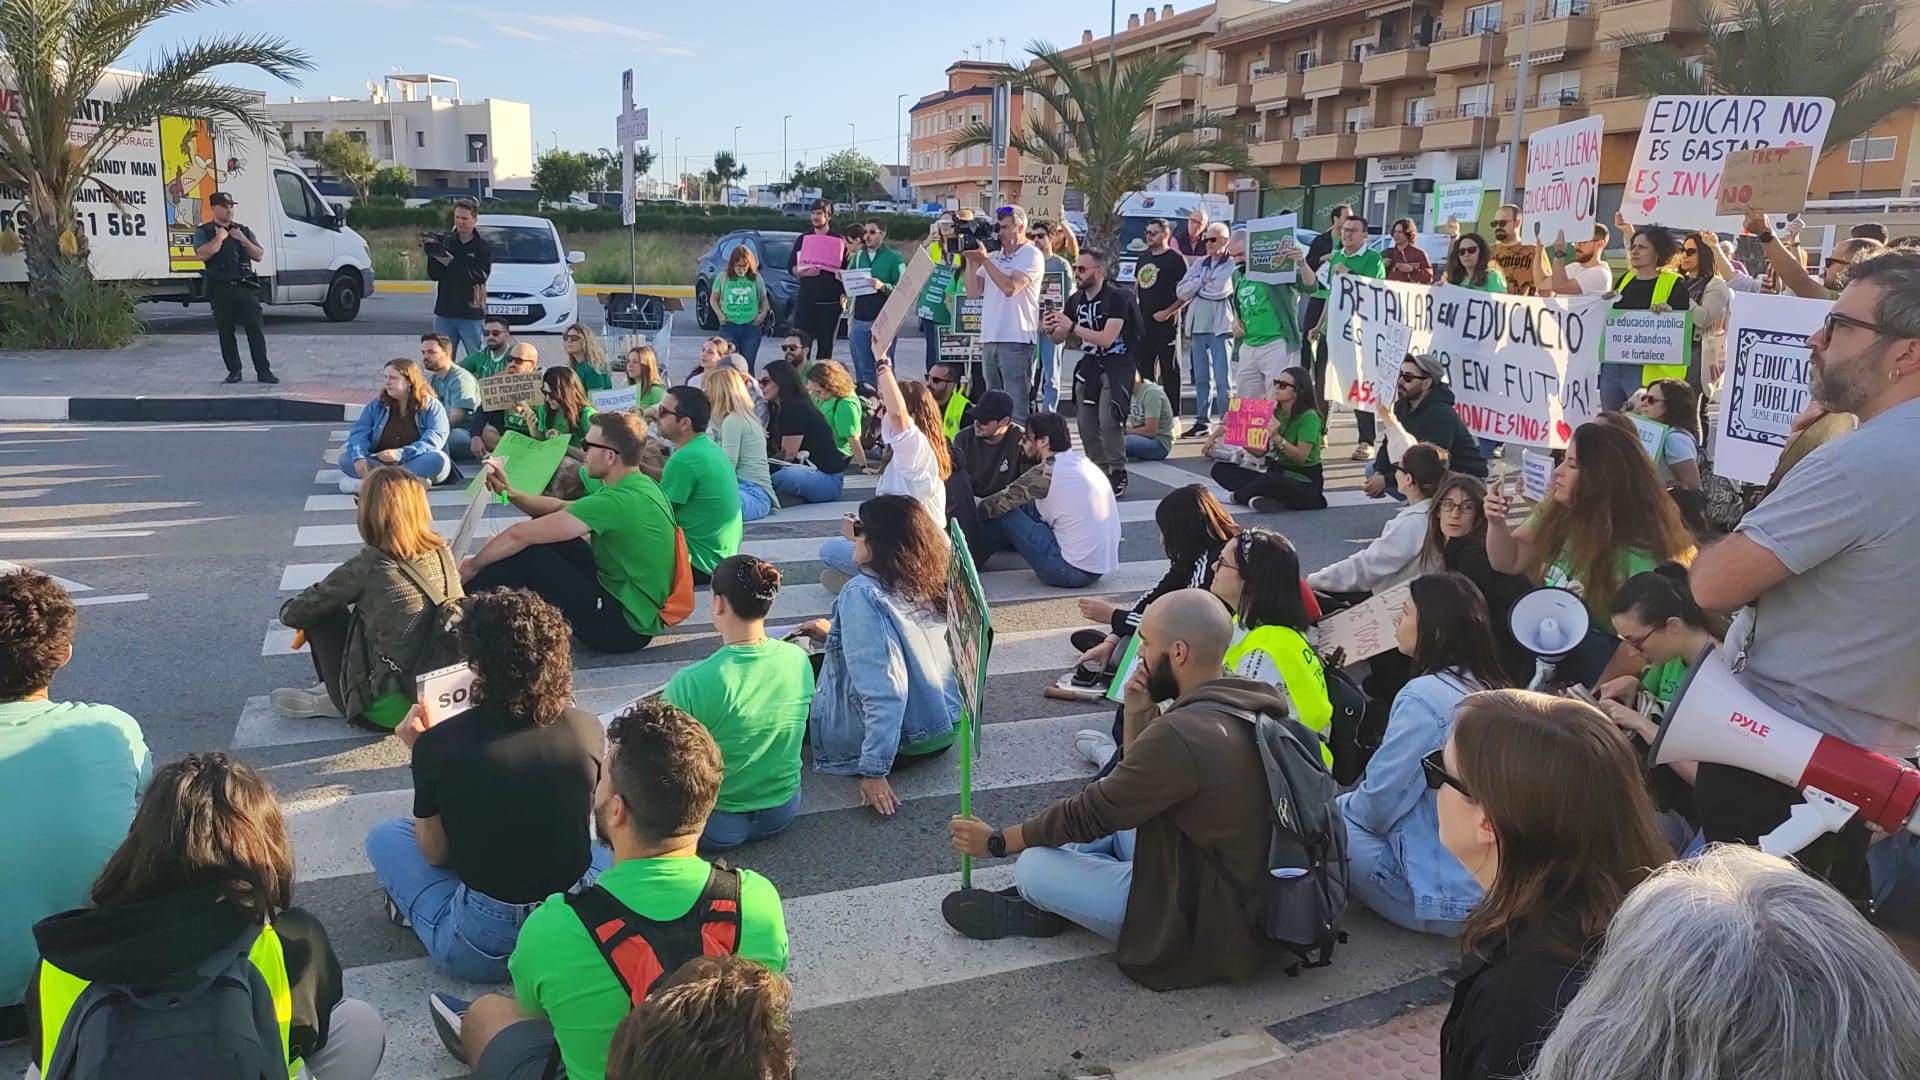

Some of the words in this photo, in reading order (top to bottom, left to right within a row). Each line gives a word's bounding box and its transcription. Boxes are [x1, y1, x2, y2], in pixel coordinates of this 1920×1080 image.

[1650, 99, 1767, 134] EDUCAR
[1779, 101, 1823, 134] NO
[1564, 130, 1599, 167] LLENA
[1648, 139, 1669, 161] ES
[131, 162, 157, 177] MAN
[1024, 175, 1062, 184] ESENCIAL
[1042, 166, 1052, 175] LO
[1037, 186, 1049, 196] ES
[1634, 169, 1661, 194] ES
[1524, 176, 1572, 214] EDUCACIÓN
[1028, 207, 1034, 216] A
[1038, 207, 1049, 216] LA
[108, 213, 147, 236] 562
[1437, 302, 1460, 328] EN
[1462, 298, 1588, 354] EDUCACIÓ
[1617, 316, 1655, 328] educación
[1657, 316, 1684, 331] pública
[1612, 334, 1622, 342] no
[1623, 334, 1632, 343] se
[1634, 332, 1673, 347] abandona,
[1621, 350, 1630, 359] se
[1631, 348, 1665, 360] fortalece
[1753, 353, 1812, 385] EDUCAC
[1462, 358, 1489, 393] EN
[1504, 365, 1592, 416] FUTUR!
[1753, 382, 1808, 414] PÚBLIC
[1751, 408, 1771, 421] SENSE
[438, 688, 467, 708] SO
